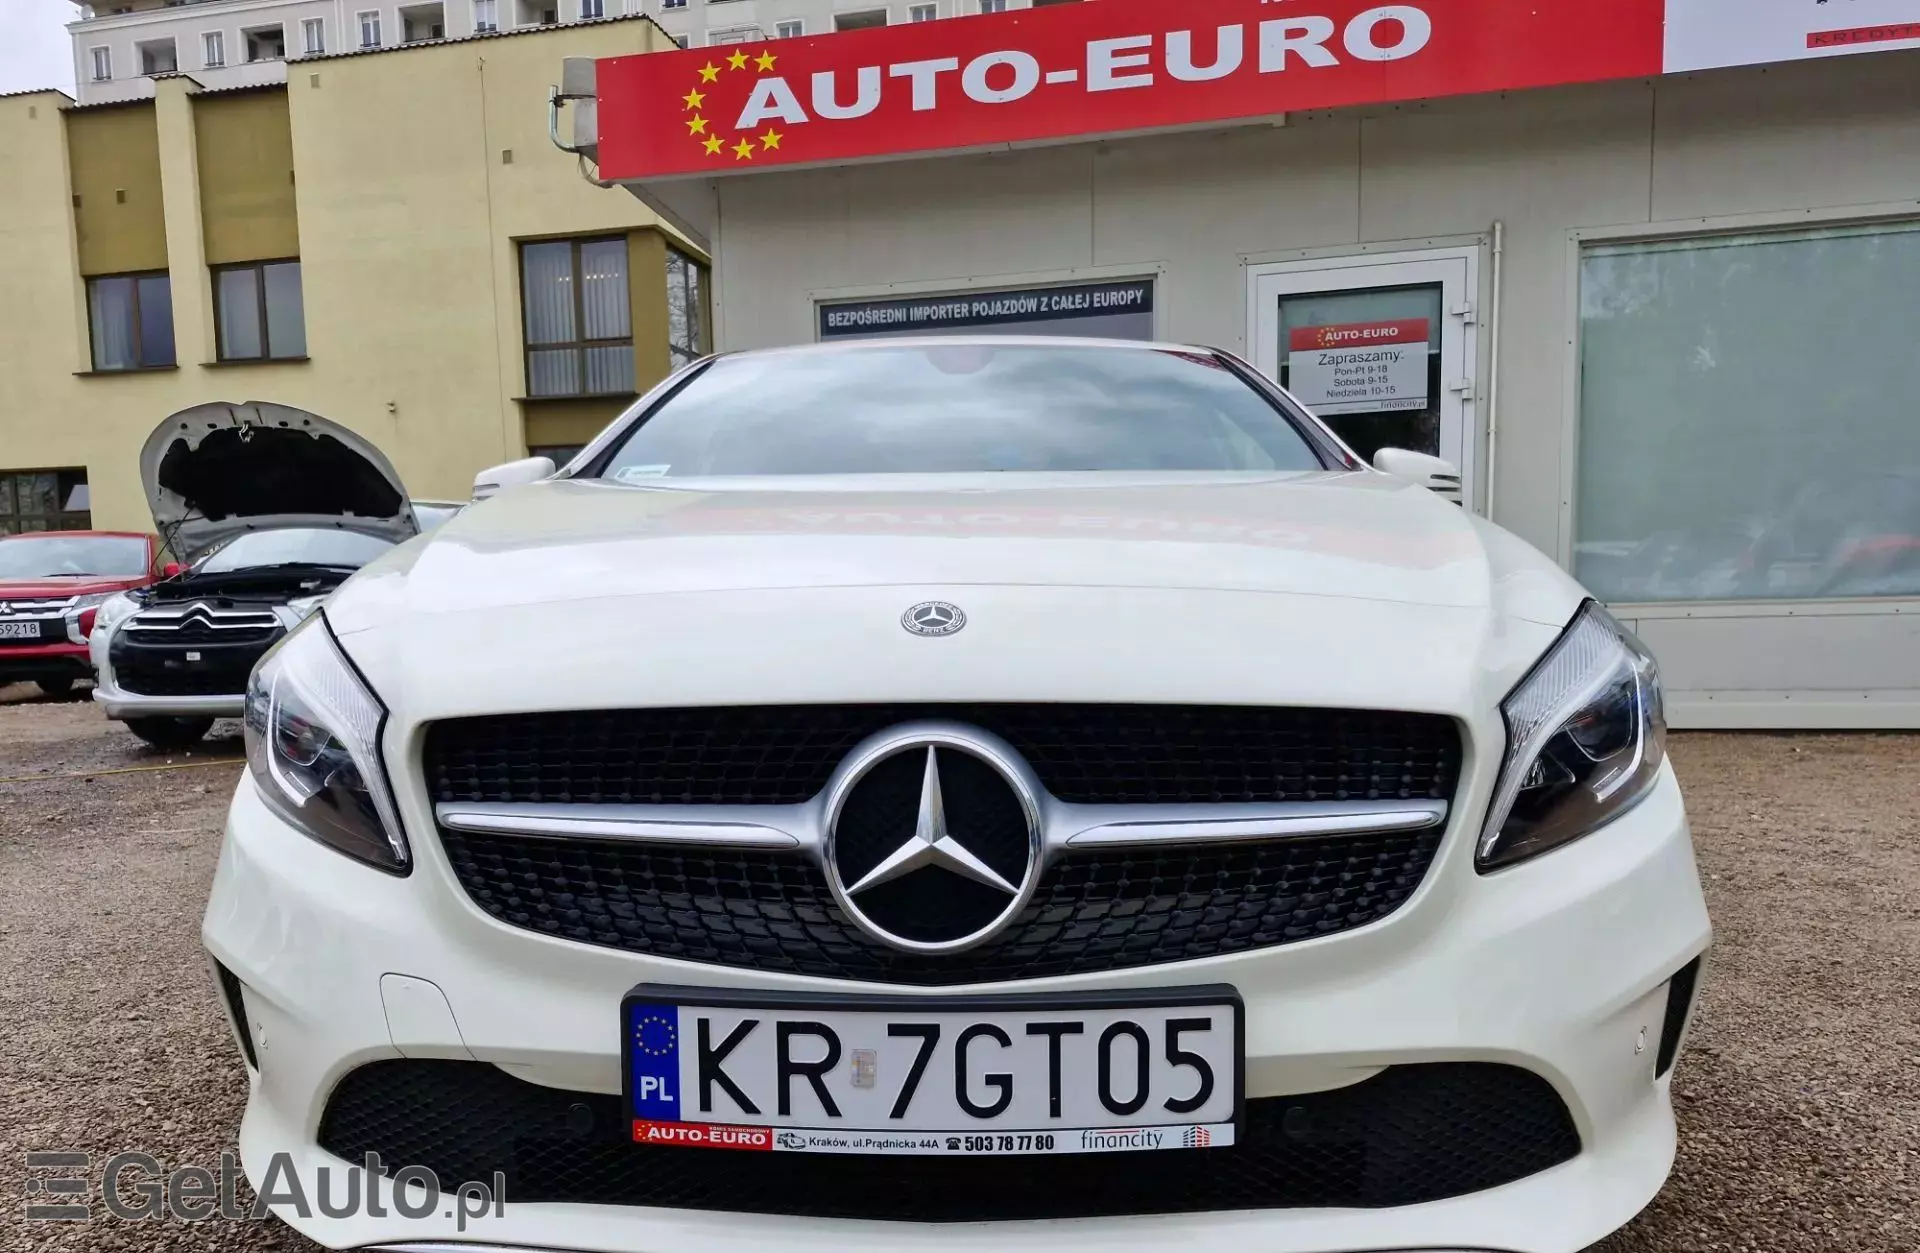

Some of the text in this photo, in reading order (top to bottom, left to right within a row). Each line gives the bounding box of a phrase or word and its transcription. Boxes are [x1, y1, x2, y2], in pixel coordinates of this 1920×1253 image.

[734, 5, 1432, 129] AUTO-EURO
[828, 289, 1144, 327] BEZPOŚREDNI IMPORTER POJAZDÓW Z CAŁEJ EUROPY
[1324, 326, 1399, 342] AUTO-EURO
[1318, 350, 1405, 367] Zapraszamy:
[1334, 365, 1388, 376] Pon-Pt 9-18
[1334, 375, 1388, 387] Sobota 9-15
[1326, 386, 1396, 398] Niedziela 10-15
[697, 1017, 1215, 1119] KR 7GT05
[640, 1076, 674, 1102] PL
[647, 1127, 766, 1145] AUTO-EURO
[809, 1137, 850, 1148] Kraków,
[919, 1139, 939, 1149] 44A
[964, 1134, 1055, 1151] 503 78 77 80
[1081, 1130, 1164, 1149] financity
